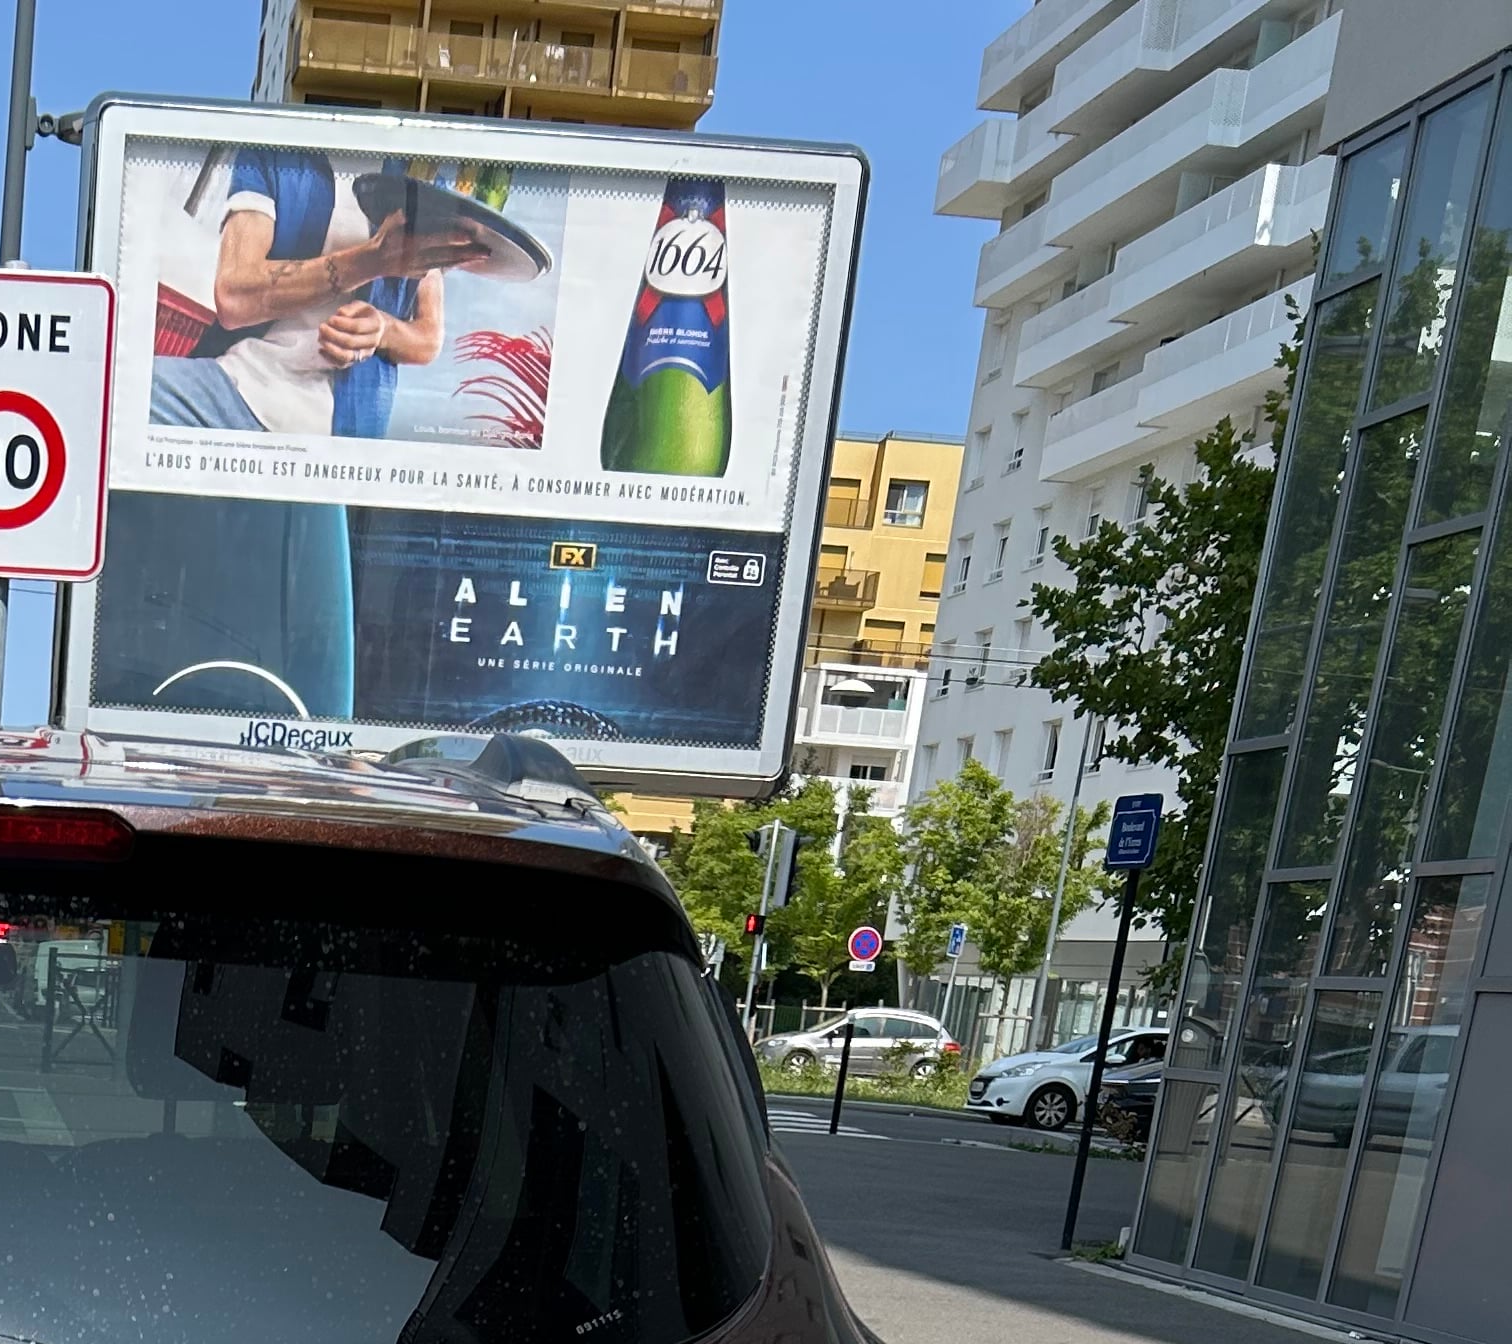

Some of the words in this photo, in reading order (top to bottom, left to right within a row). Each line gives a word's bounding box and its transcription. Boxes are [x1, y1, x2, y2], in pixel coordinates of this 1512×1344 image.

[649, 230, 725, 281] 1664
[145, 452, 191, 470] L'ABUS
[200, 456, 264, 475] D'ALCOOL
[273, 461, 296, 477] EST
[305, 463, 382, 483] DANGEREUX
[390, 468, 425, 485] POUR
[433, 471, 448, 487] LA
[456, 472, 504, 491] SANTÉ,
[512, 477, 520, 491] À
[528, 477, 611, 497] CONSOMMER
[619, 484, 652, 500] AVEC
[660, 484, 751, 507] MODÉRATION.
[560, 548, 586, 566] FX
[454, 577, 683, 617] ALIEN
[450, 617, 678, 656] EARTH
[478, 658, 505, 668] UNE
[513, 658, 556, 671] SÉRIE
[564, 663, 643, 677] ORIGINALE
[246, 720, 353, 748] JCDecaux
